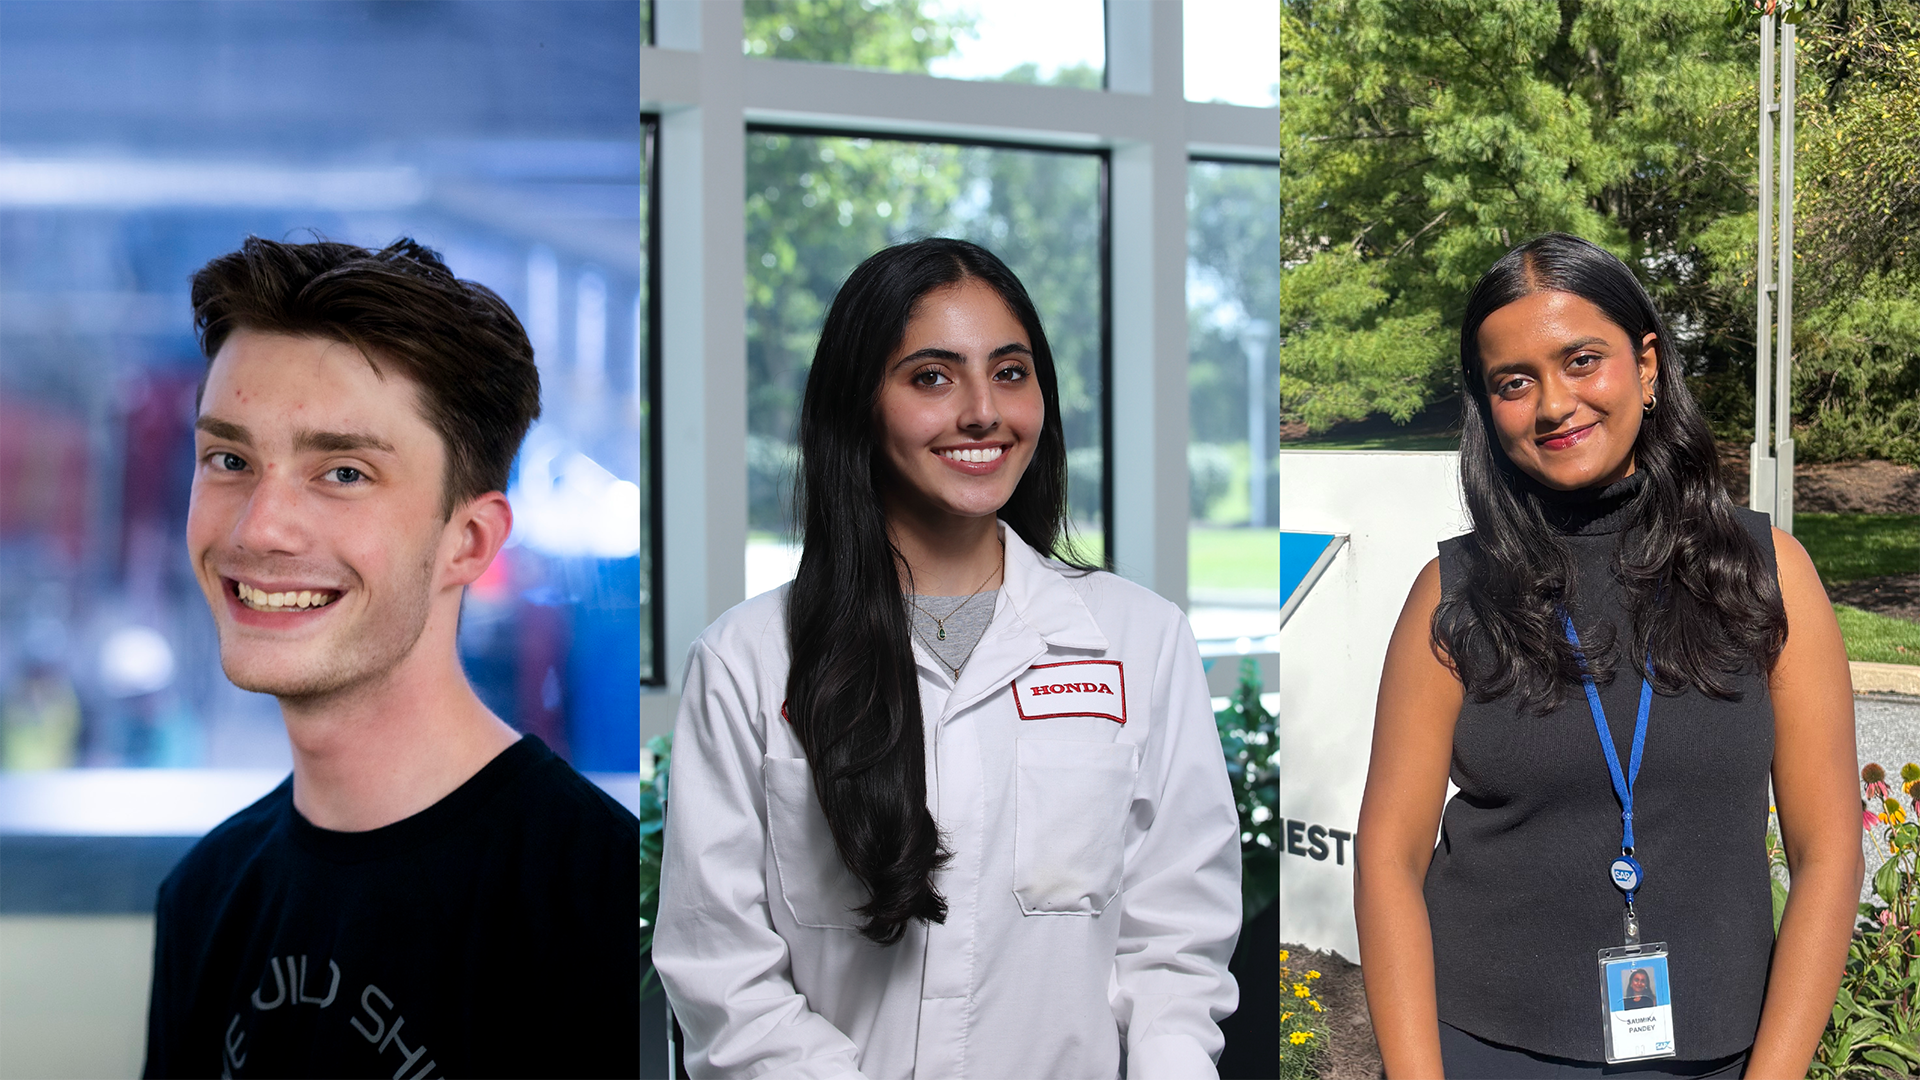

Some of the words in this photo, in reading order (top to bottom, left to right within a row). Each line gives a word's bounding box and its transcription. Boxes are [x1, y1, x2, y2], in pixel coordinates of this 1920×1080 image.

[1030, 682, 1114, 696] HONDA
[1614, 870, 1631, 880] SAP
[251, 955, 340, 1010] UILD
[350, 985, 445, 1080] SHI
[1629, 1024, 1655, 1033] PANDEY
